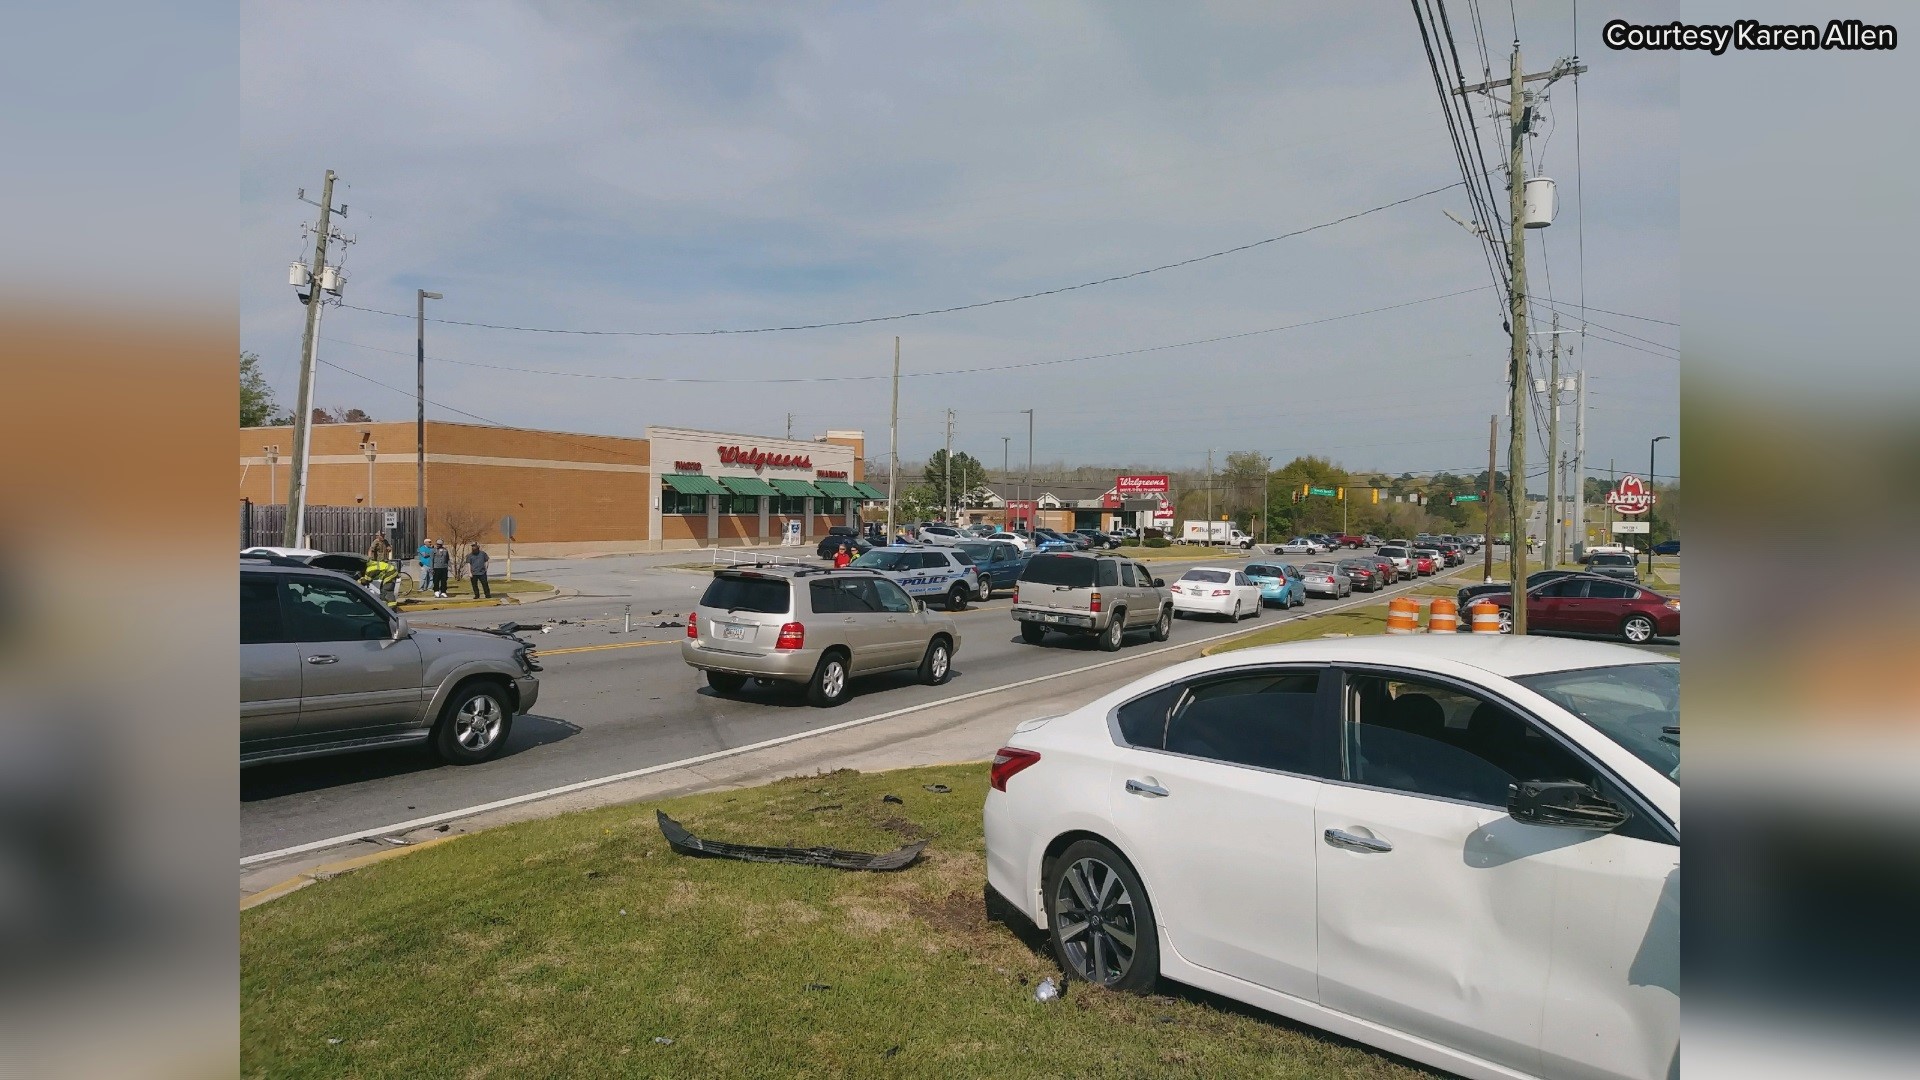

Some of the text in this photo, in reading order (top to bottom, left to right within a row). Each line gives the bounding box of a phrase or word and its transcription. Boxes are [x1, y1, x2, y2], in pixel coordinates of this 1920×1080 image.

[717, 445, 813, 471] Walgreens
[1119, 477, 1166, 488] Walgreens
[1607, 491, 1656, 507] Arby's
[1199, 527, 1222, 535] Buget
[901, 576, 948, 587] POLICE
